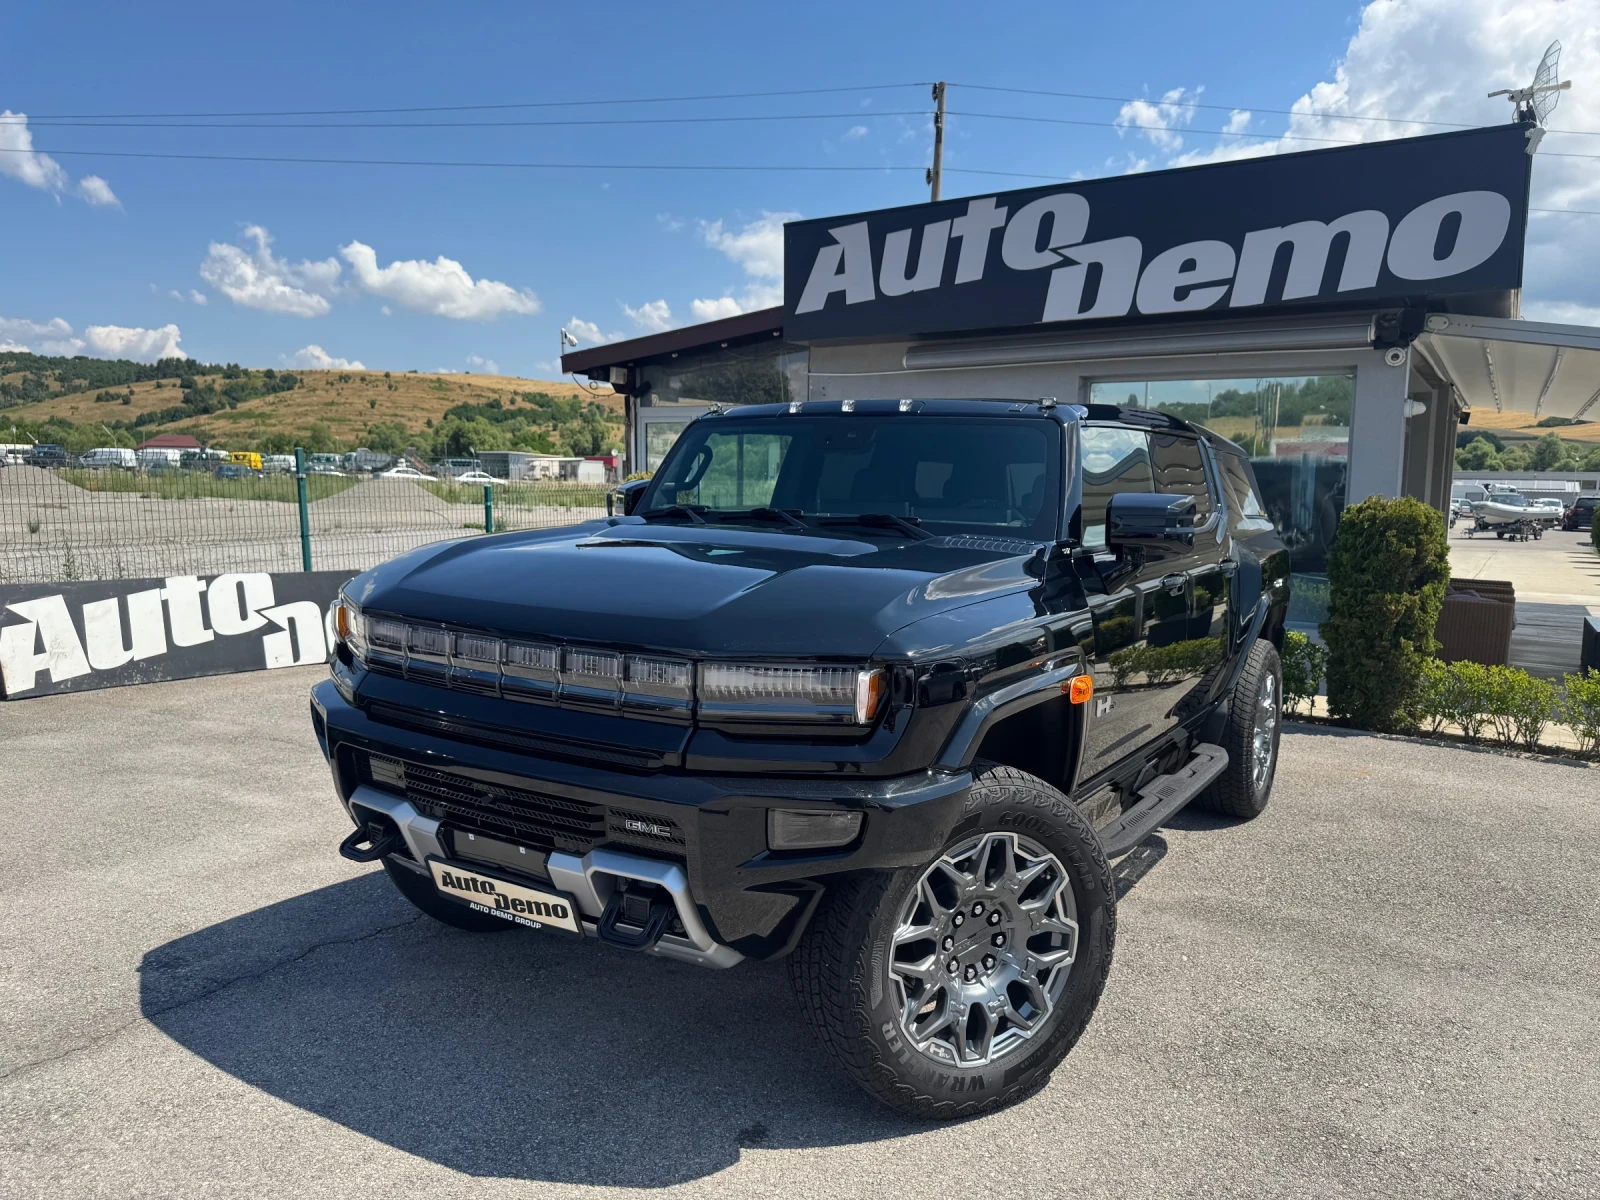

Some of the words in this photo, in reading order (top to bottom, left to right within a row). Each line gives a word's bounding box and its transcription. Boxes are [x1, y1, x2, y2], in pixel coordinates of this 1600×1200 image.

[795, 193, 1090, 315] Auto
[1042, 190, 1511, 322] Demo
[0, 573, 275, 695] Auto
[259, 601, 335, 669] D
[625, 819, 671, 837] GMC
[442, 870, 496, 896] Auto
[492, 892, 569, 919] Demo
[469, 902, 489, 914] AUTO
[490, 908, 513, 921] DEMO
[514, 916, 542, 930] GROUP
[881, 1020, 986, 1093] WRANGLER
